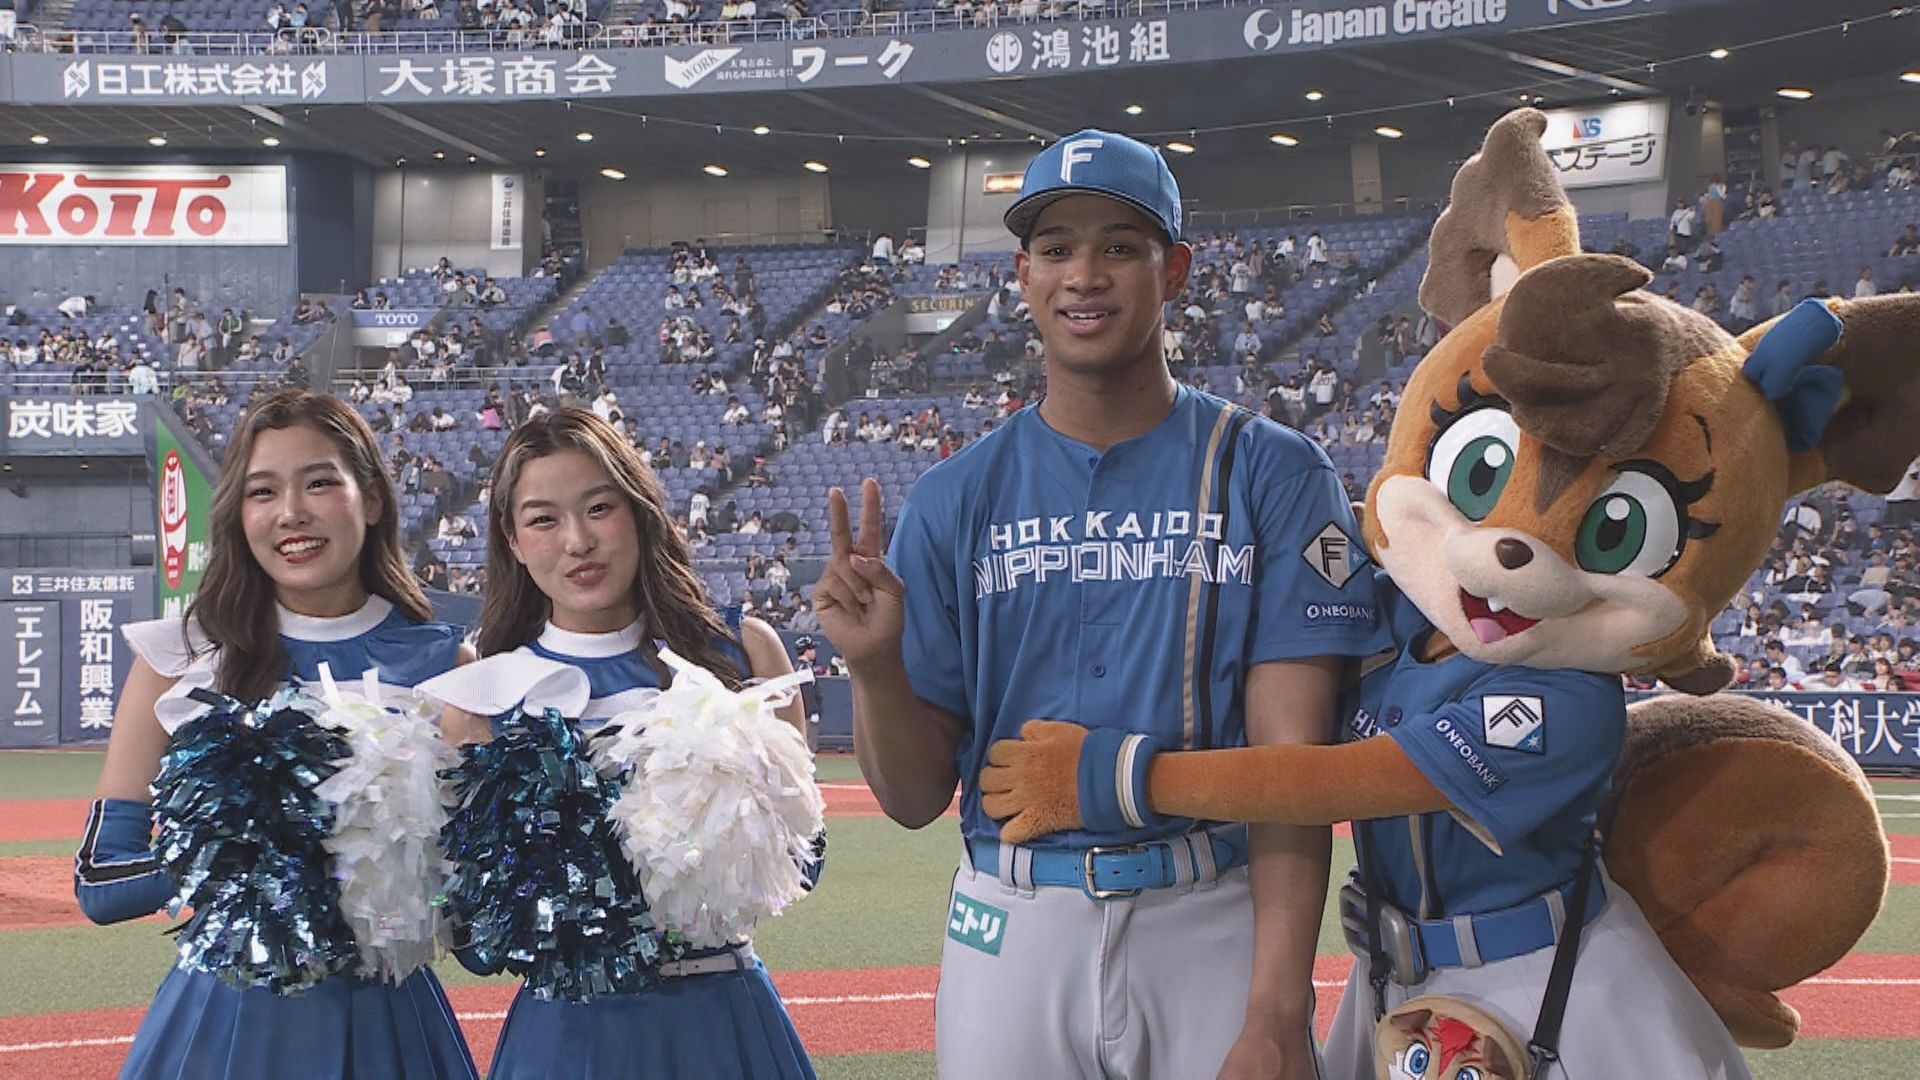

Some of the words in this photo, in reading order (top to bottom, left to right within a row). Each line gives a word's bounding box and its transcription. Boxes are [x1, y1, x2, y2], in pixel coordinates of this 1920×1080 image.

[681, 53, 718, 81] WORK
[792, 39, 915, 83] ワーク
[1031, 20, 1170, 71] 鴻池組
[97, 62, 298, 95] 日工株式会社
[379, 54, 617, 97] 大塚商会
[1060, 138, 1104, 184] F
[375, 313, 418, 325] TOTO
[8, 400, 138, 438] 炭味家
[990, 509, 1224, 550] HOKKAIDO
[973, 539, 1255, 599] NIPPONHAM
[1320, 537, 1347, 578] F
[37, 576, 135, 592] 三井住友信託
[15, 616, 44, 716] エレコム
[79, 598, 114, 730] 阪和興業
[950, 901, 1001, 944] ニトリ
